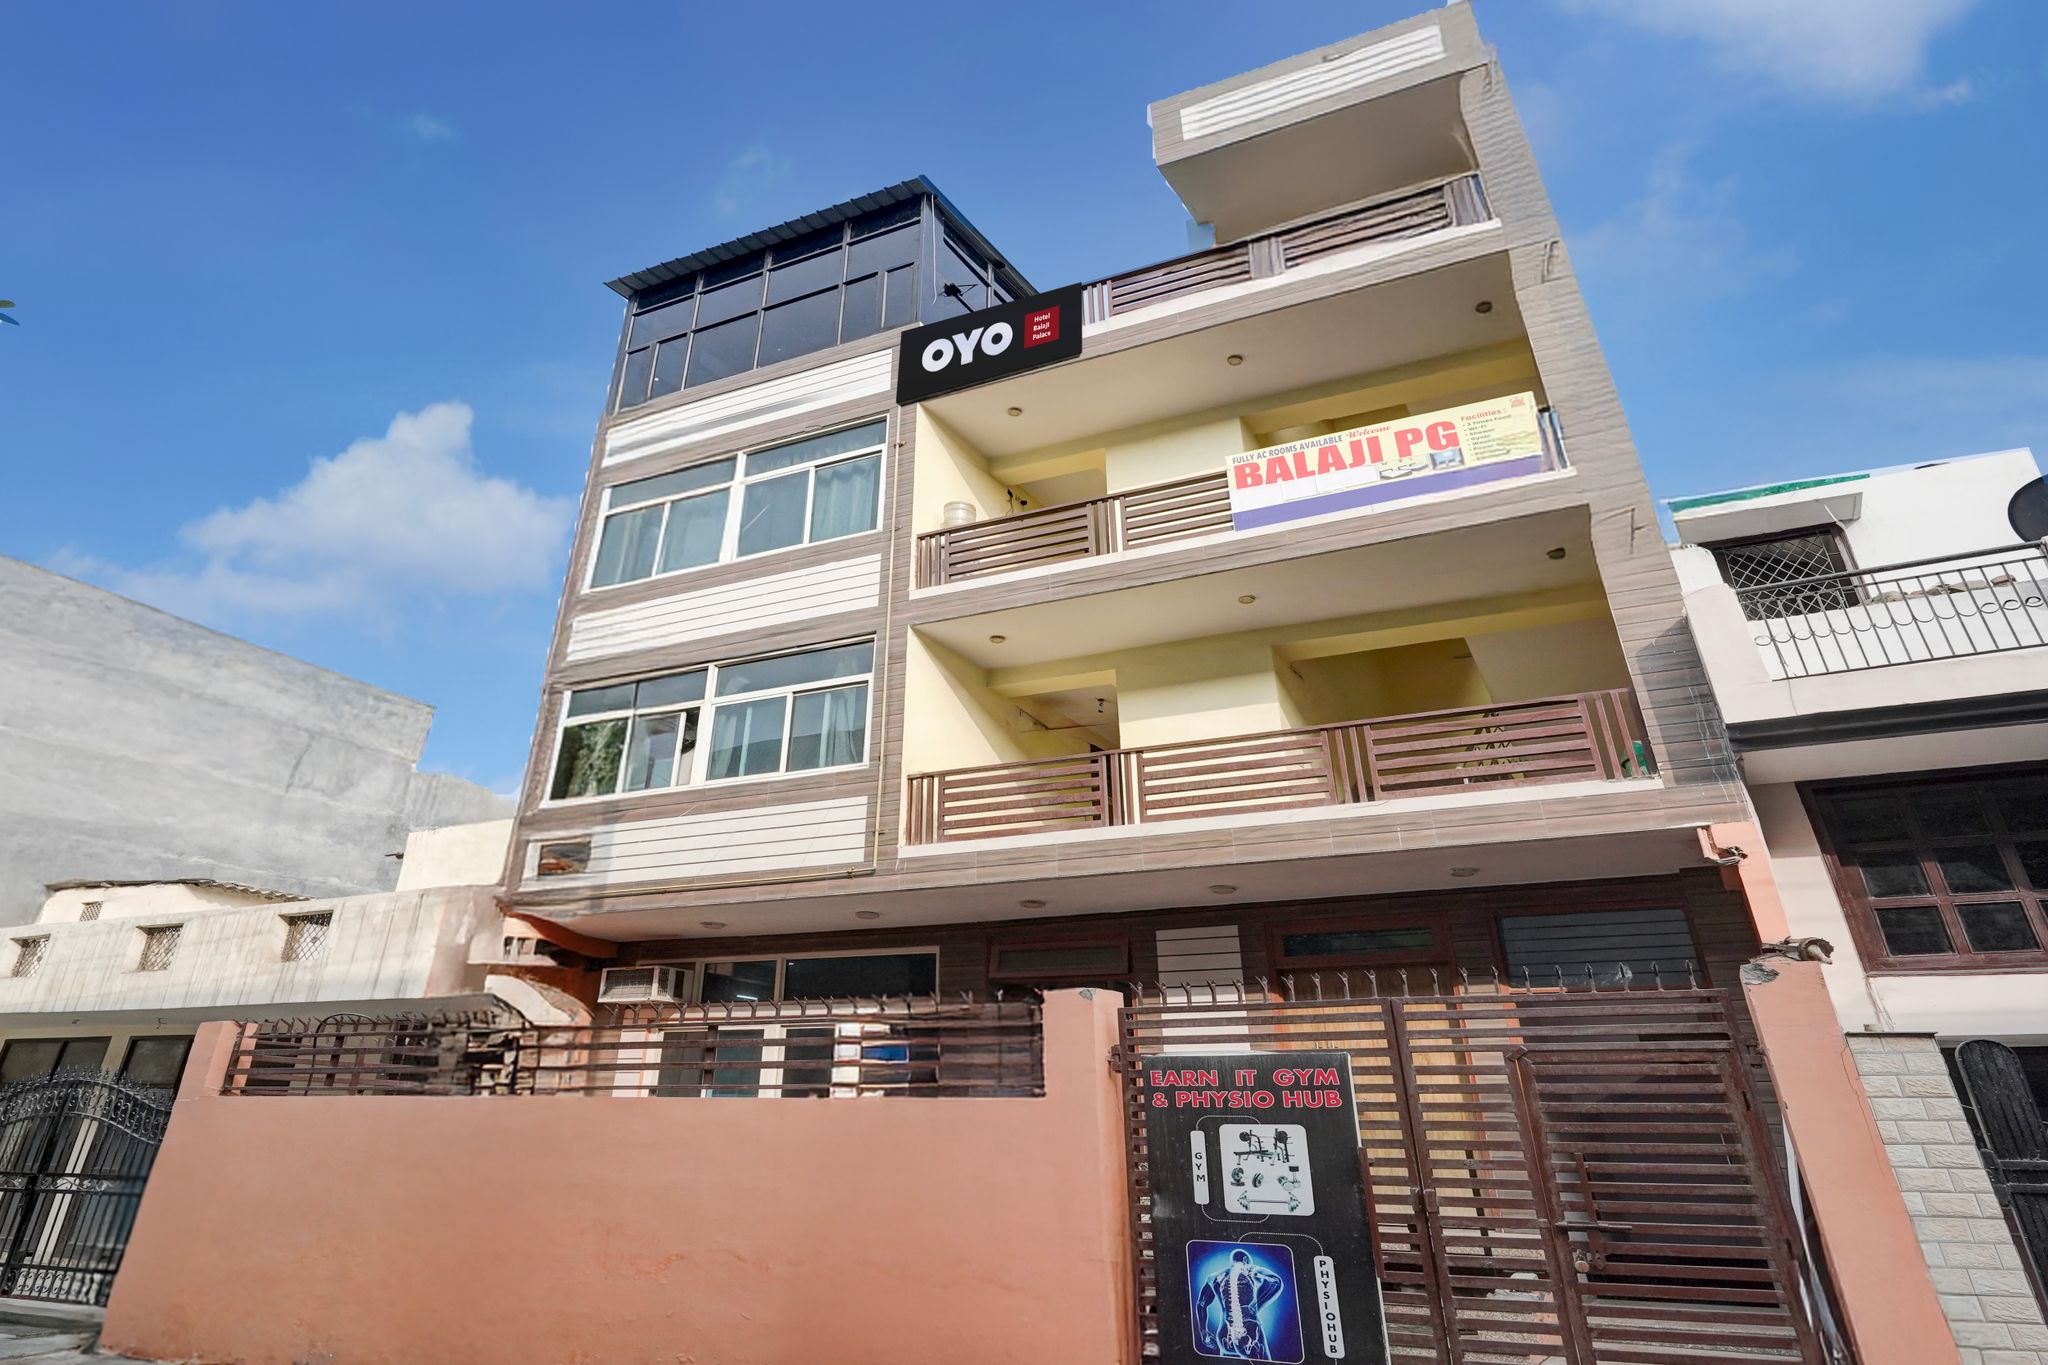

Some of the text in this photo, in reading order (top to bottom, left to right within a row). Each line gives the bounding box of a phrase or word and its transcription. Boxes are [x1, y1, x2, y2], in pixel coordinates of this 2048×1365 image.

[1033, 321, 1050, 332] Balaji
[1034, 312, 1051, 323] Hotel
[1032, 331, 1051, 340] Palace
[922, 322, 1013, 373] OYO
[1345, 425, 1391, 439] Welcome
[1232, 434, 1343, 464] FULLY AC ROOMS AVAILABLE
[1233, 421, 1460, 489] BALAJI PG
[1150, 1067, 1340, 1087] EARN IT GYM
[1152, 1090, 1343, 1108] & PHYSIO HUB
[1194, 1152, 1206, 1182] GYM
[1319, 1260, 1338, 1354] PHYSIOHUB
